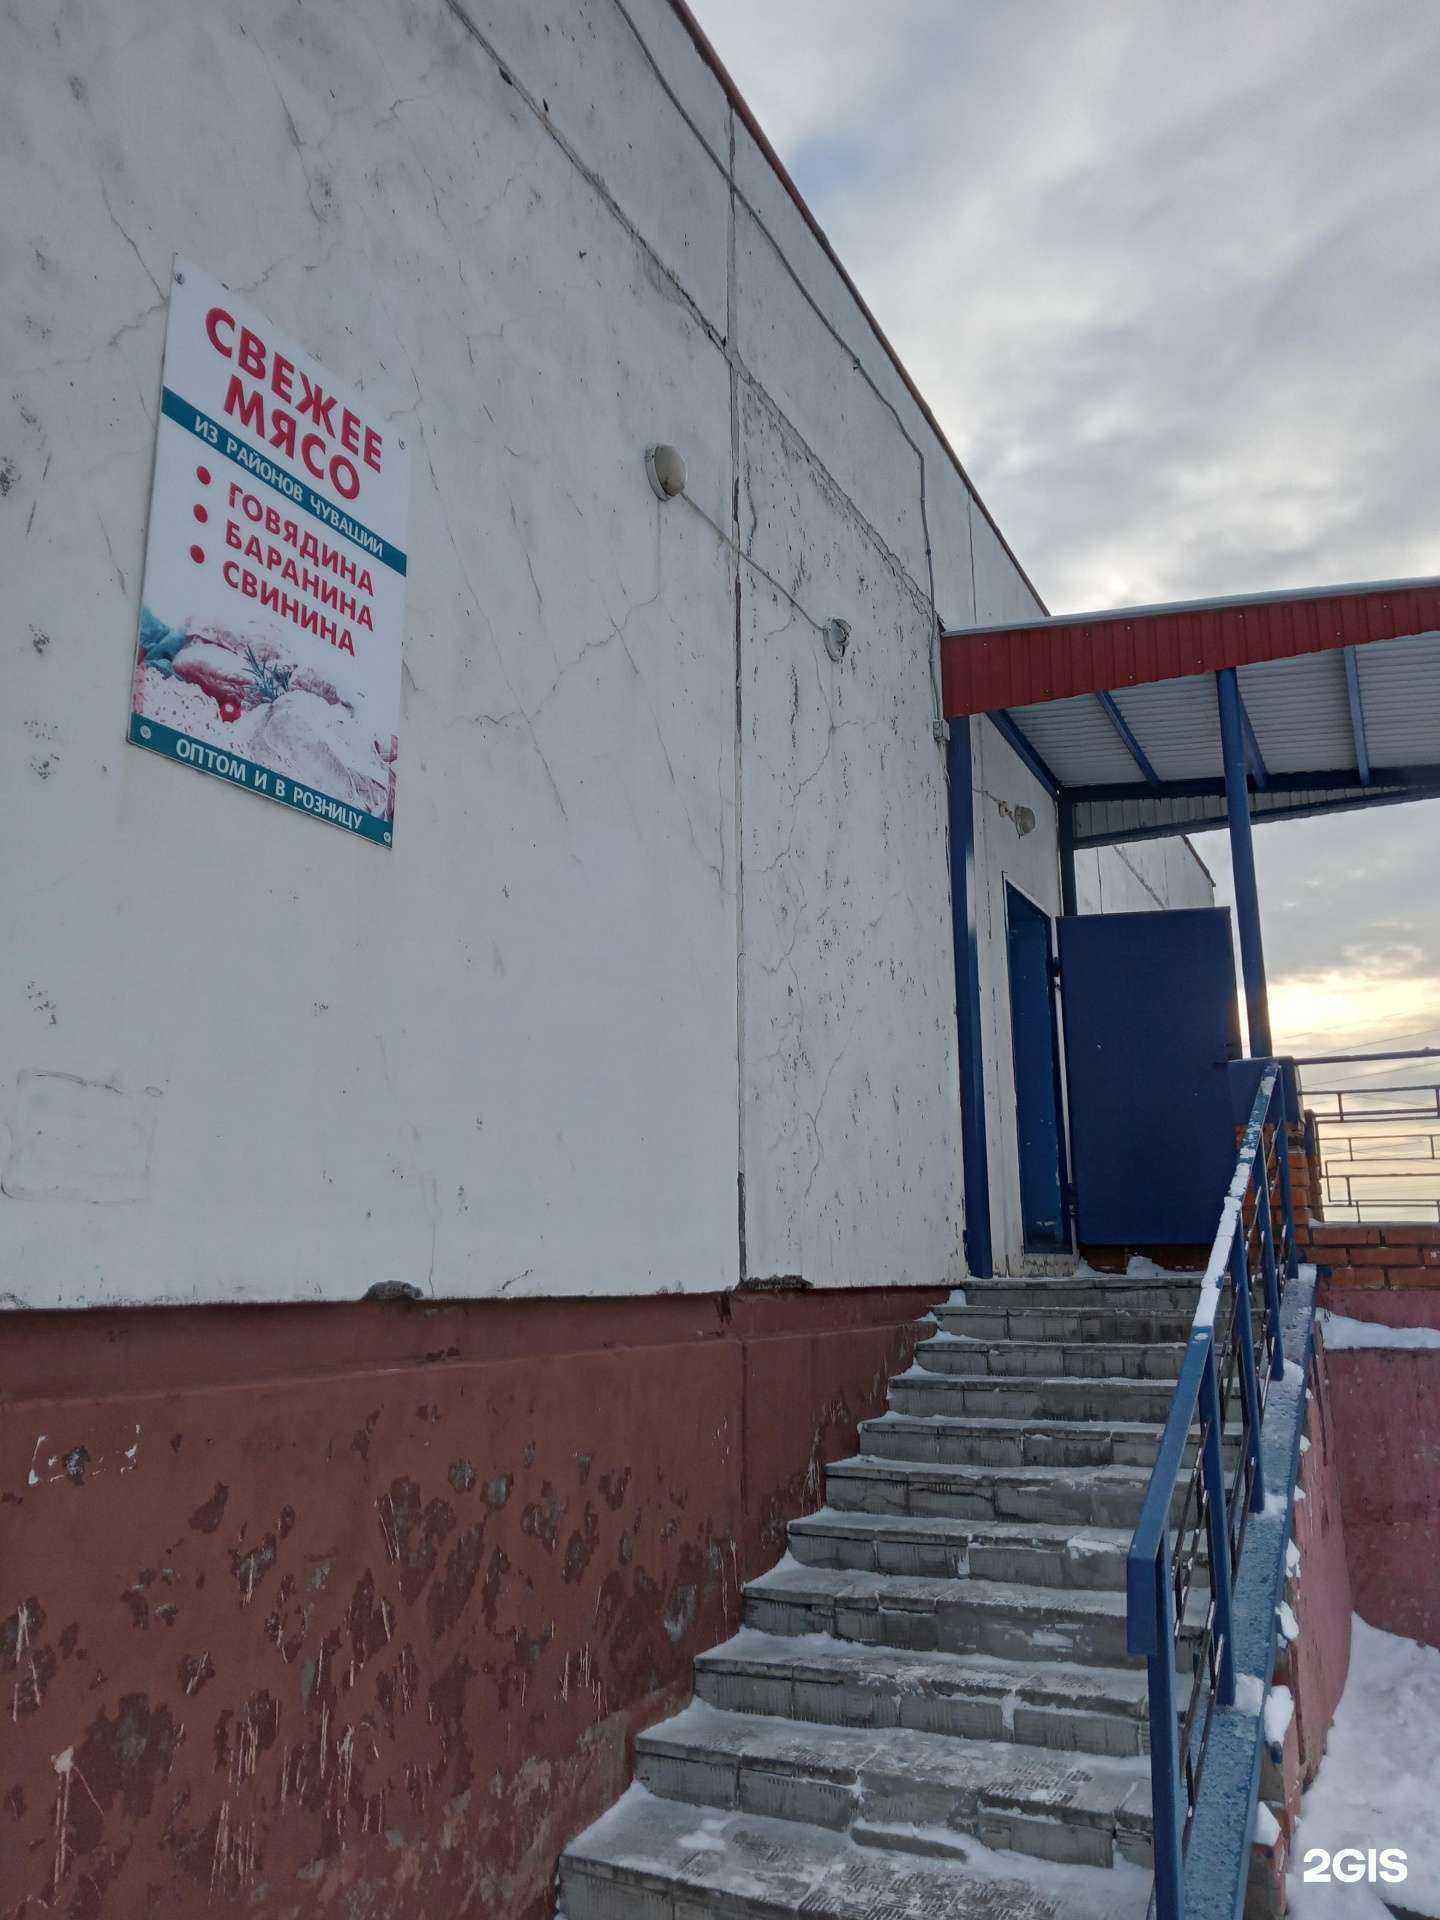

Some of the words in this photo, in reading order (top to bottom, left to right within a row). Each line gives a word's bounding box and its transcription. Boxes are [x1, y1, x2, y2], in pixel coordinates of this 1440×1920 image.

[205, 307, 383, 474] СВЕЖЕЕ
[223, 374, 360, 500] МЯСО
[194, 415, 219, 443] ИЗ
[226, 440, 303, 501] РАЙОНОВ
[310, 494, 383, 557] ЧУВАШИИ
[228, 482, 374, 597] ГОВЯДИНА
[223, 560, 355, 657] СВИНИНА
[225, 519, 374, 632] БАРАНИНА
[176, 738, 246, 781] ОПТОМ
[254, 772, 268, 790] И
[275, 780, 286, 797] В
[293, 786, 363, 830] РОЗНИЦУ
